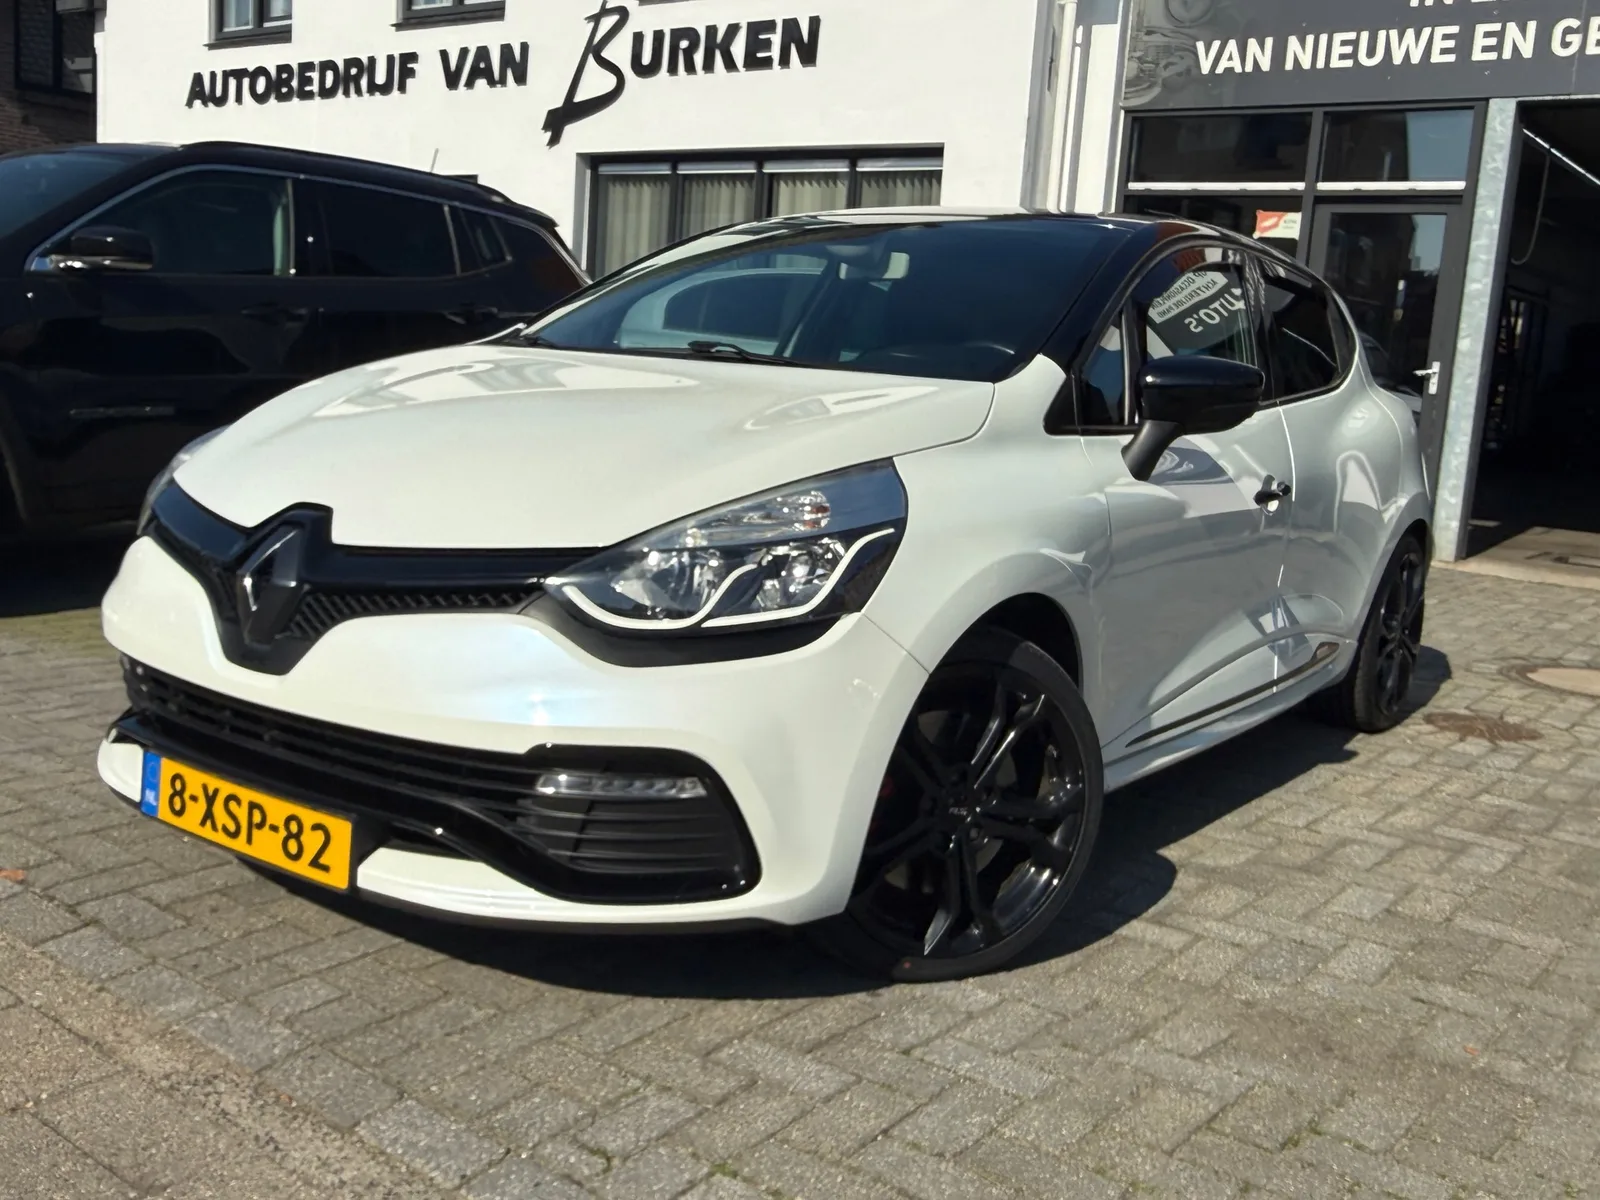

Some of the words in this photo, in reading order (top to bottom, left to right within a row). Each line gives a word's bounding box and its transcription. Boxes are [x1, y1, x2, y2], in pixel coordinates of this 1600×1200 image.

[185, 52, 419, 109] AUTOBEDRIJF
[439, 41, 529, 91] VAN
[541, 0, 821, 149] BURKEN
[1195, 36, 1273, 75] VAN
[1284, 25, 1460, 71] NIEUWE
[1471, 20, 1537, 61] EN
[168, 773, 331, 873] 8-XSP-82
